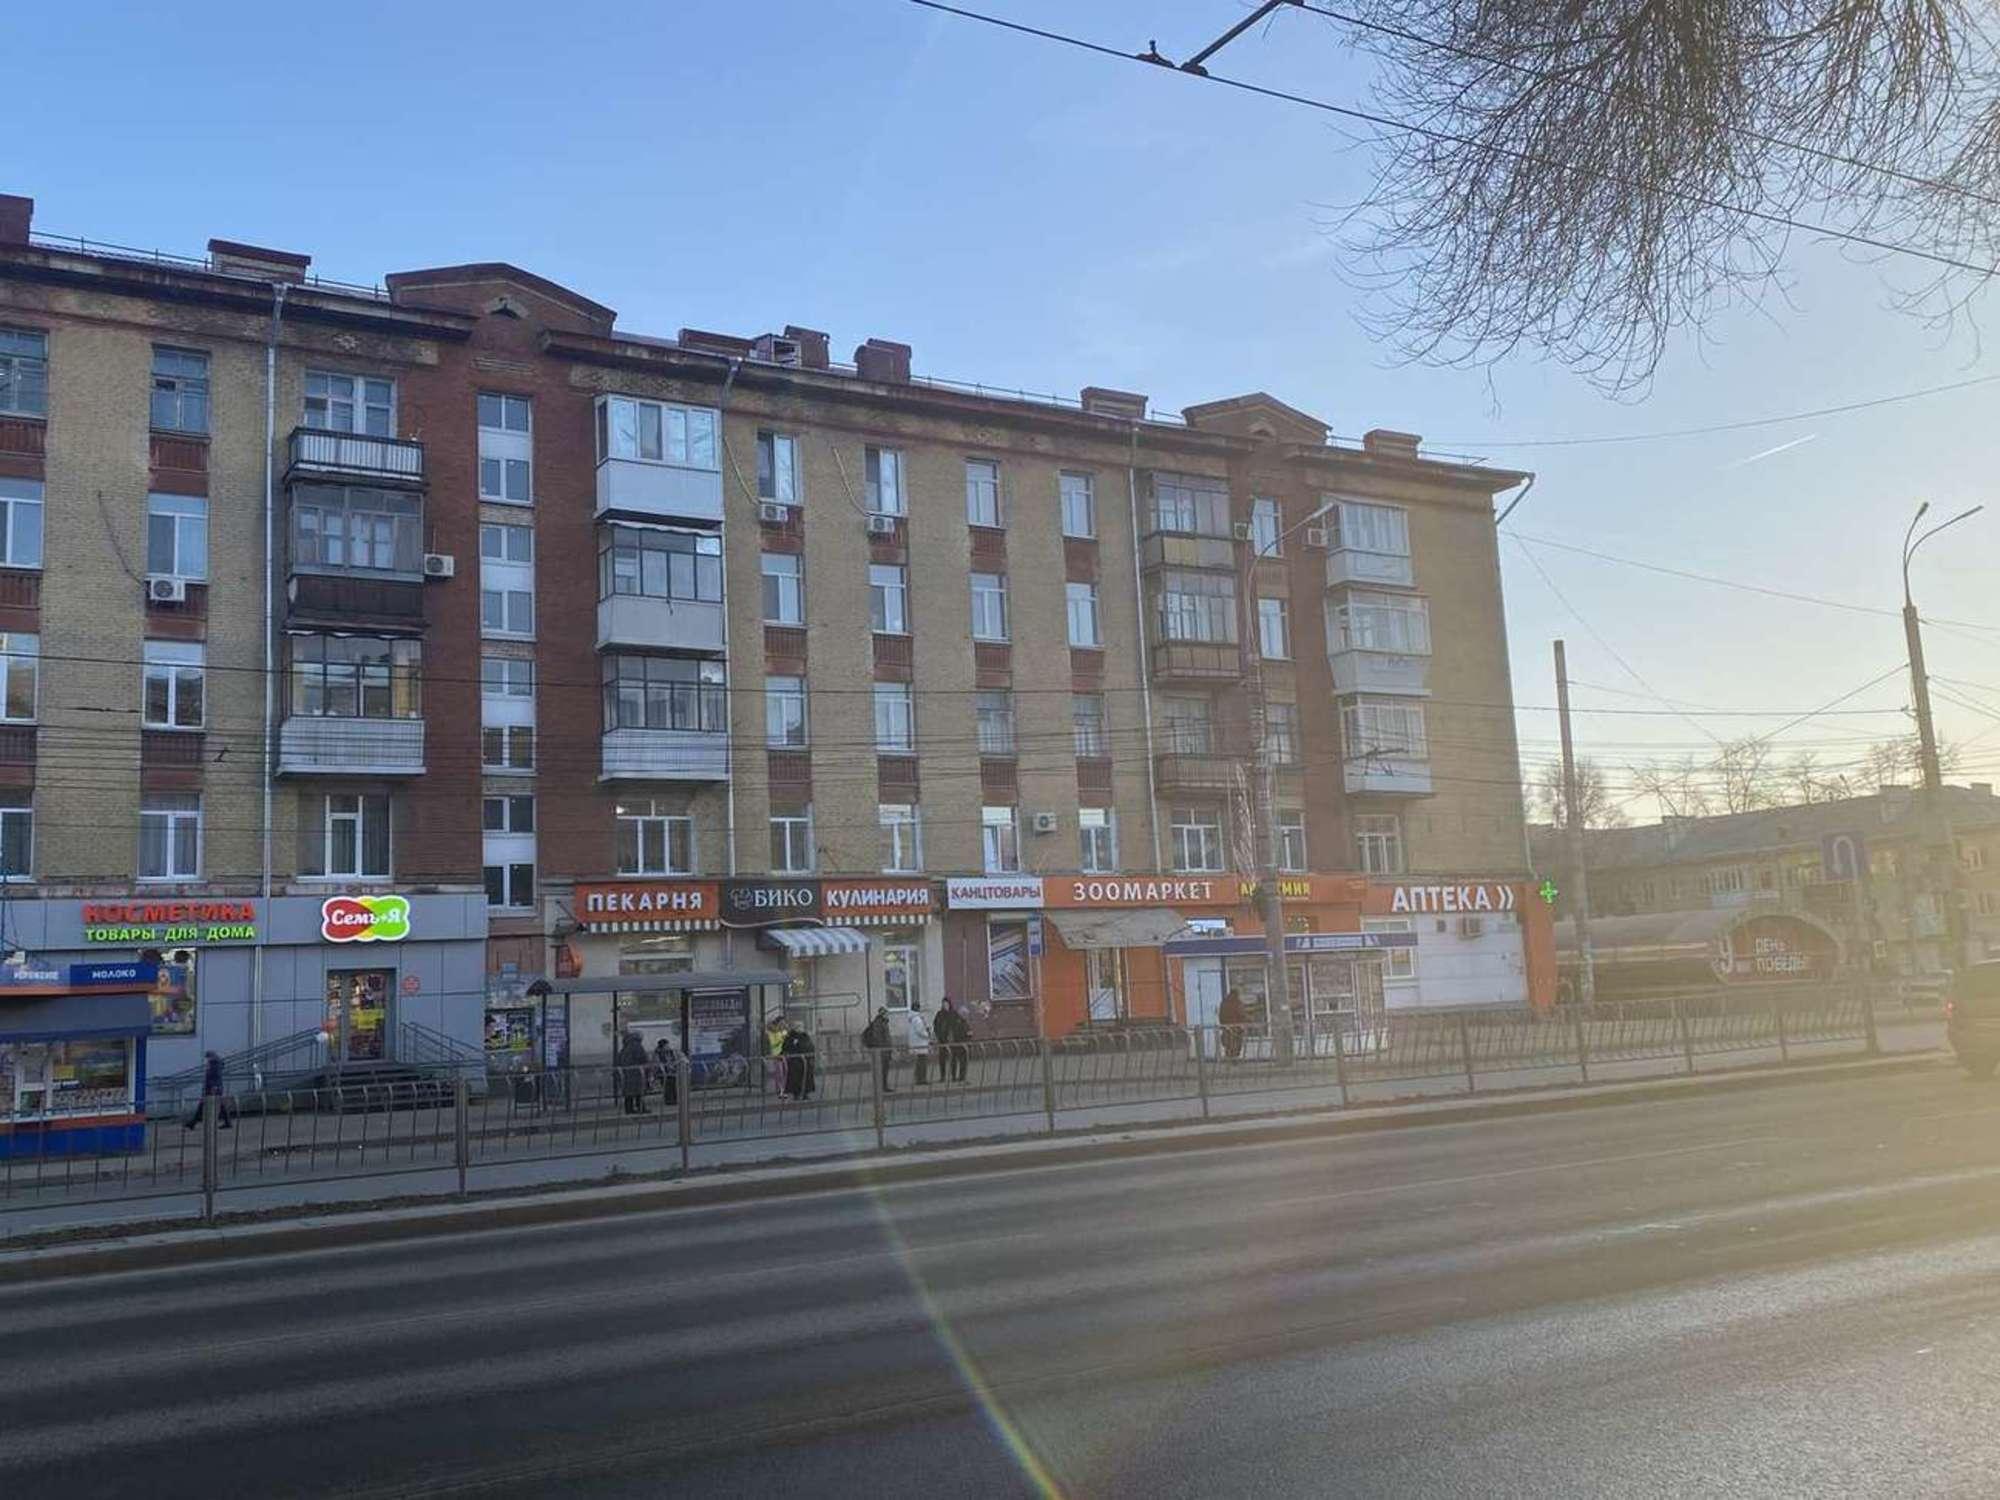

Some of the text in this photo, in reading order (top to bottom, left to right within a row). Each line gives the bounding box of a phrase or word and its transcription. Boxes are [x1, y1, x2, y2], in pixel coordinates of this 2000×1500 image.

[754, 888, 813, 907] БИКО
[827, 888, 929, 908] КУЛИНАРИЯ
[951, 885, 1041, 901] КАНЦТОВАРЫ
[1073, 881, 1213, 902] ЗООМАРКЕТ
[1392, 886, 1492, 912] АПТЕКА
[587, 891, 703, 912] ПЕКАРНЯ
[86, 925, 256, 941] ТОВАРЫ ДЛЯ ДОМА
[92, 968, 137, 980] МОЛОКО
